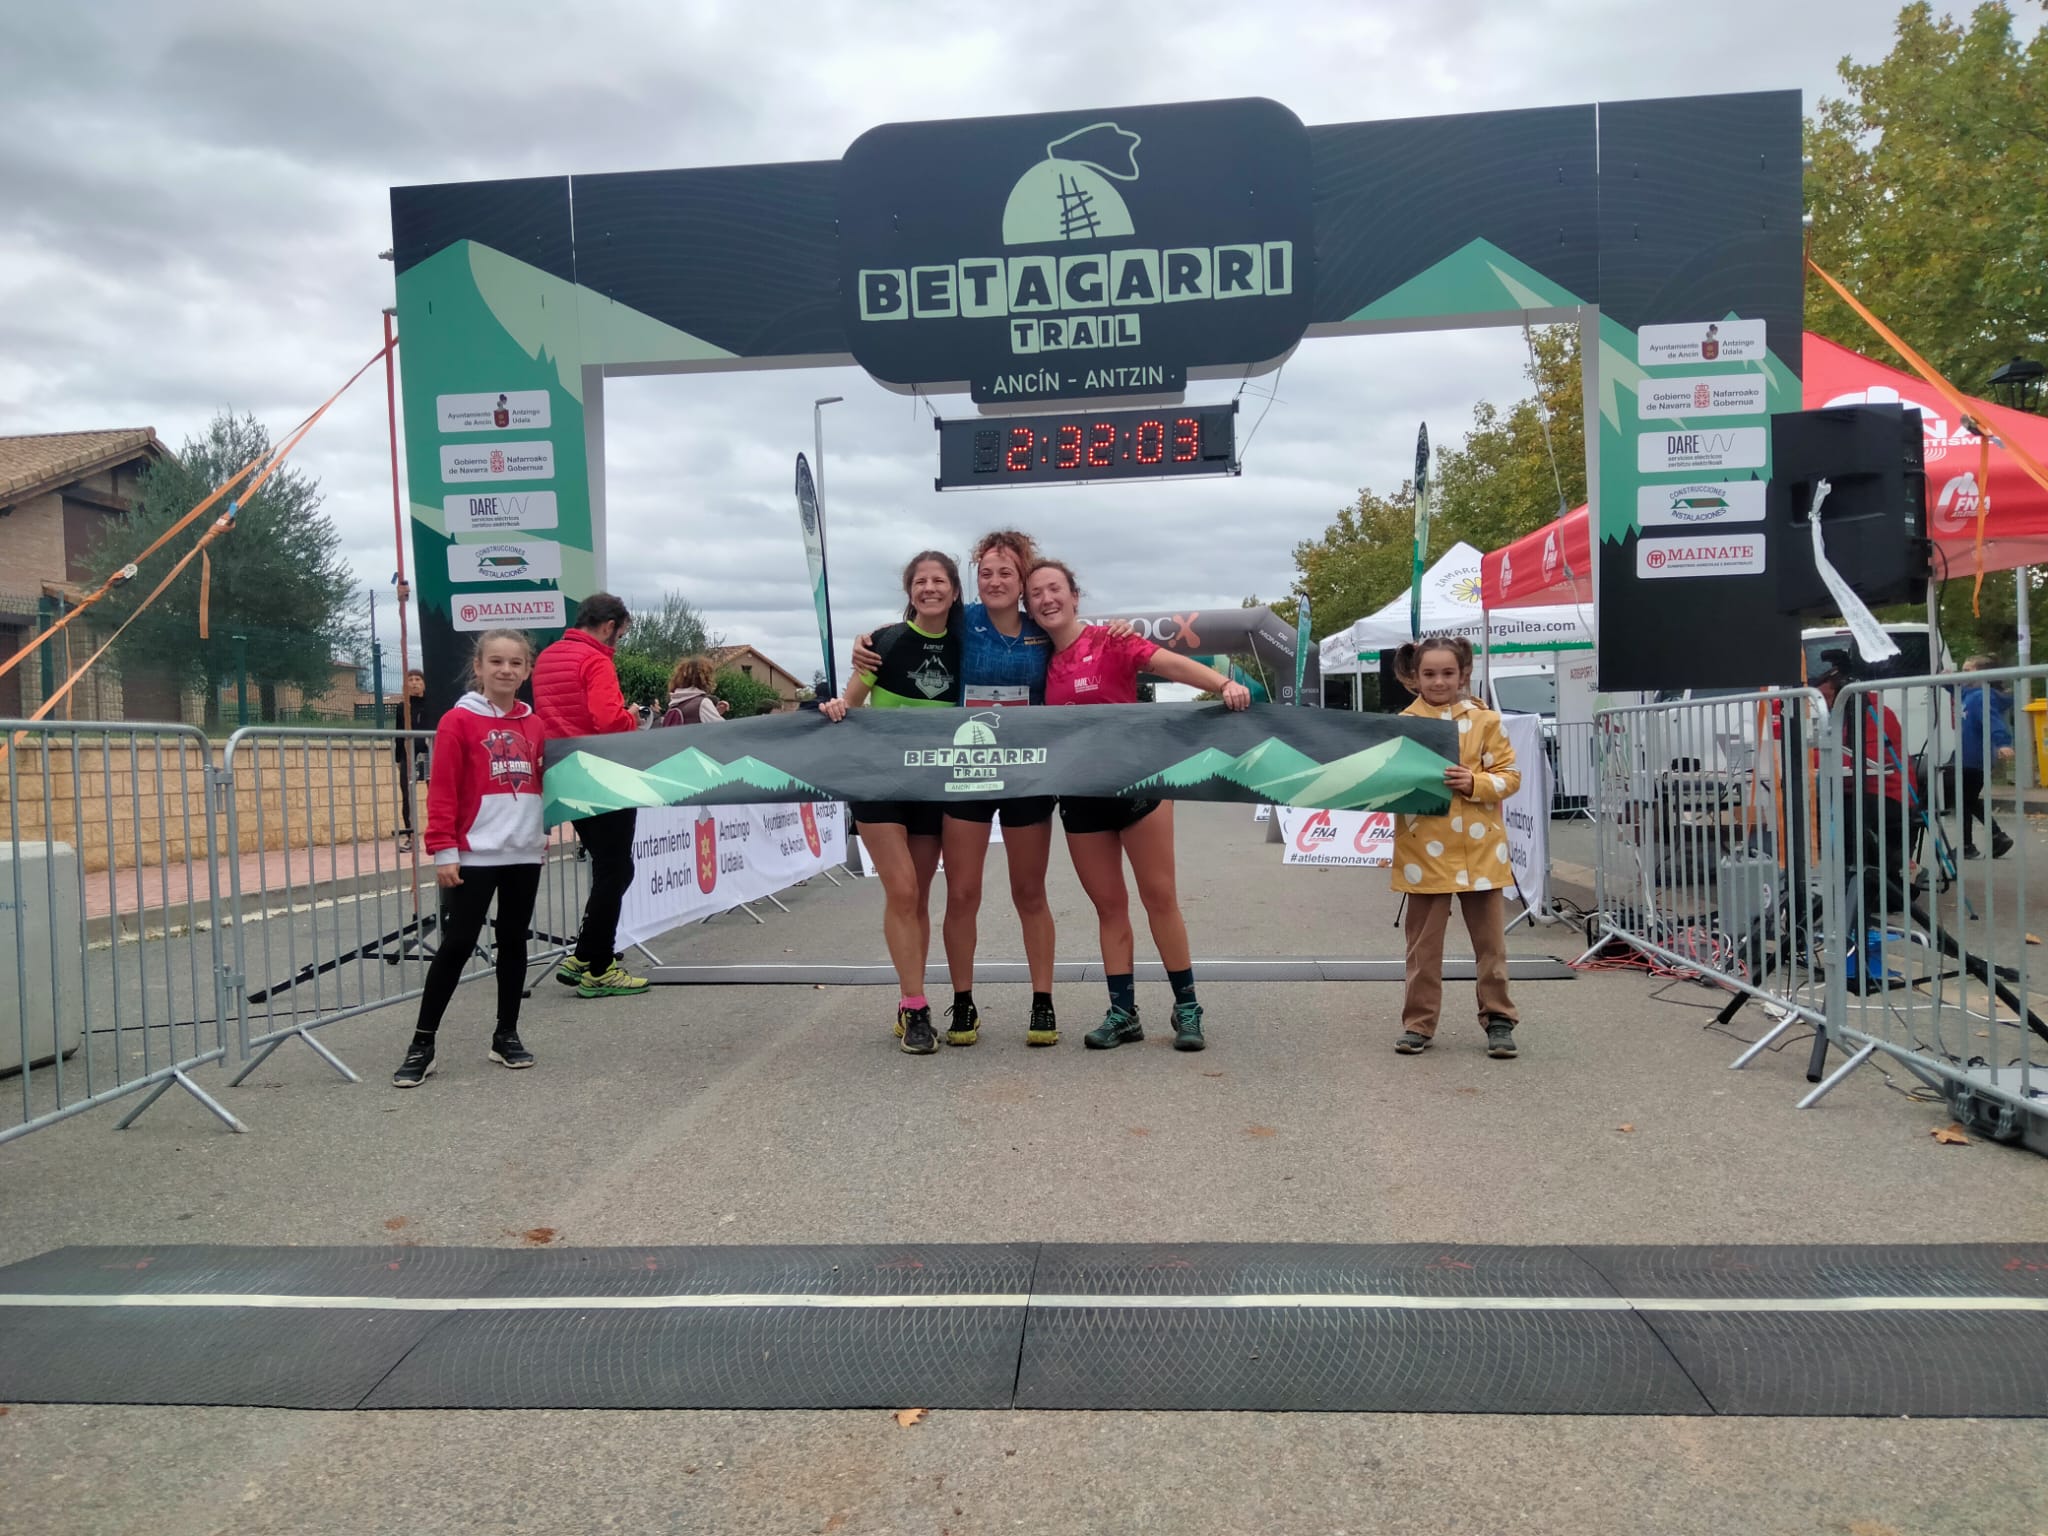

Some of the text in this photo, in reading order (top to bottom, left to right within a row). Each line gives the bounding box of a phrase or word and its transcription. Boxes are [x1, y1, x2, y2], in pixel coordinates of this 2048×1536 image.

[862, 245, 1289, 317] BETAGARRI
[1012, 317, 1138, 350] TRAIL
[1649, 343, 1699, 353] Ayuntamiento
[1722, 339, 1755, 348] Antzingo
[993, 368, 1060, 395] ANCÍN
[1084, 365, 1164, 390] ANTZIN
[1653, 392, 1691, 401] Gobierno
[1713, 388, 1760, 397] Nafarroako
[1646, 401, 1691, 411] de Navarra
[1713, 398, 1754, 407] Gobernua
[1006, 417, 1199, 471] 2:32:03
[1668, 434, 1700, 455] DARE
[454, 458, 488, 466] Gobierno
[506, 455, 548, 463] Nafarroako
[448, 466, 489, 475] de Navarra
[507, 464, 544, 472] Gobernua
[1669, 485, 1727, 500] CONSTRUCCIONES
[470, 496, 499, 516] DARE
[1671, 507, 1727, 521] INSTALACIONES
[475, 545, 526, 558] CONSTRUCCIONES
[1667, 545, 1754, 561] MAINATE
[478, 565, 528, 578] INSTALACIONES
[1435, 567, 1482, 588] ZAMARG
[479, 601, 555, 616] MAINATE
[905, 748, 1046, 765] BETAGARRI
[954, 767, 997, 778] TRAIL
[719, 820, 750, 843] Antzingo
[1311, 827, 1338, 838] FNA
[631, 830, 691, 860] yuntamiento
[720, 854, 744, 874] Udala
[651, 866, 692, 895] de Ancín
